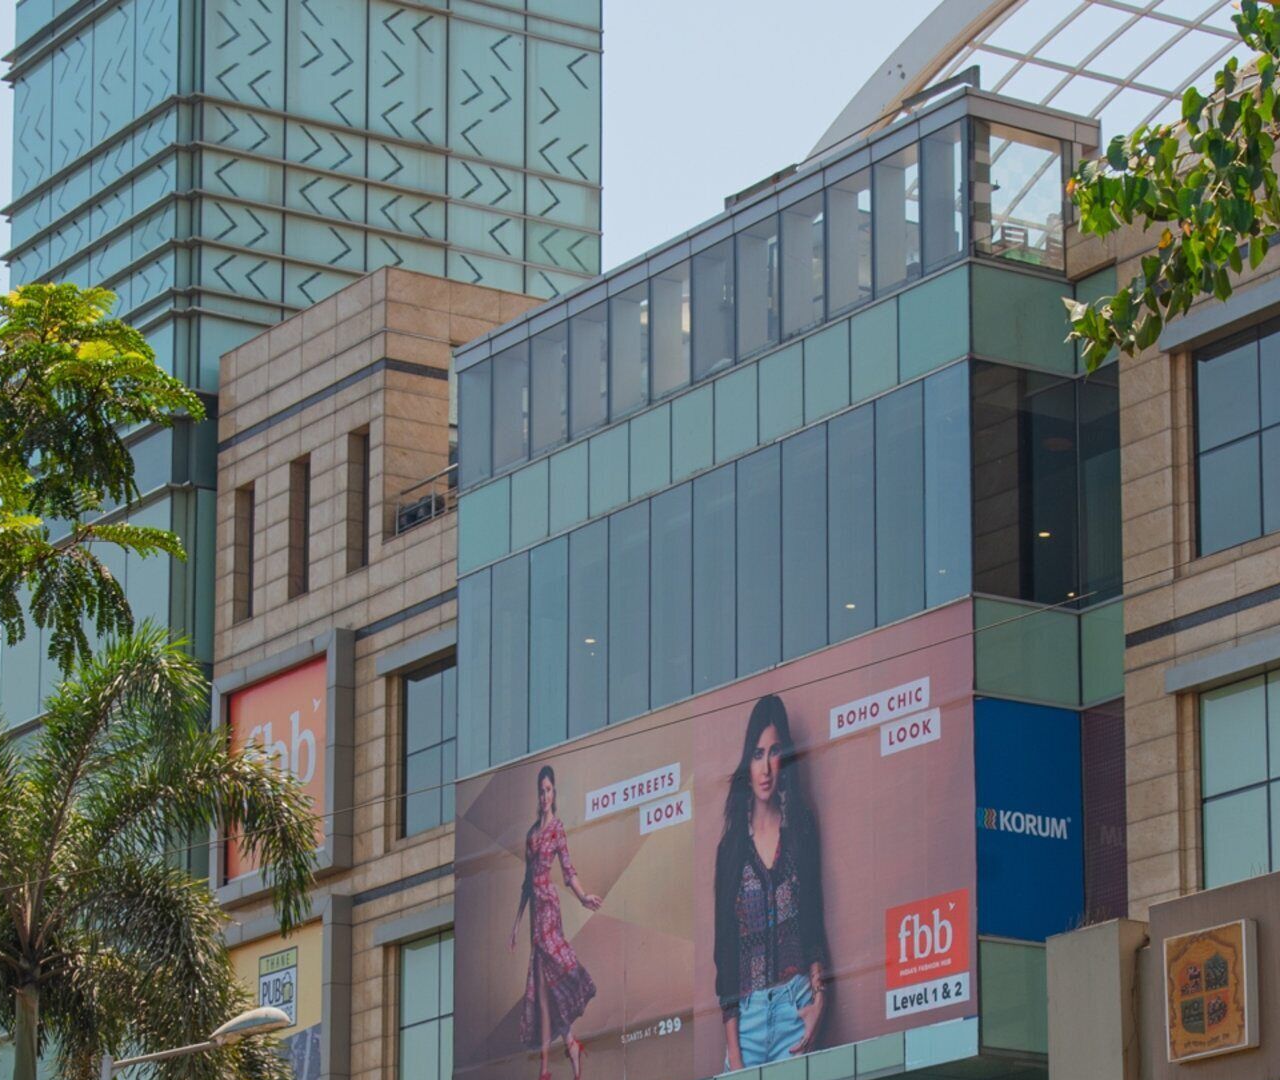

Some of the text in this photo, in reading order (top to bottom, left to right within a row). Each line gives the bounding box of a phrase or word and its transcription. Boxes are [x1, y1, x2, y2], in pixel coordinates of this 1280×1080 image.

[836, 686, 923, 729] BOHO CHIC
[888, 717, 932, 746] LOOK
[591, 771, 674, 812] HOT STREETS
[646, 800, 684, 826] LOOK
[898, 907, 953, 964] fbb
[892, 981, 963, 1012] Level 1 & 2
